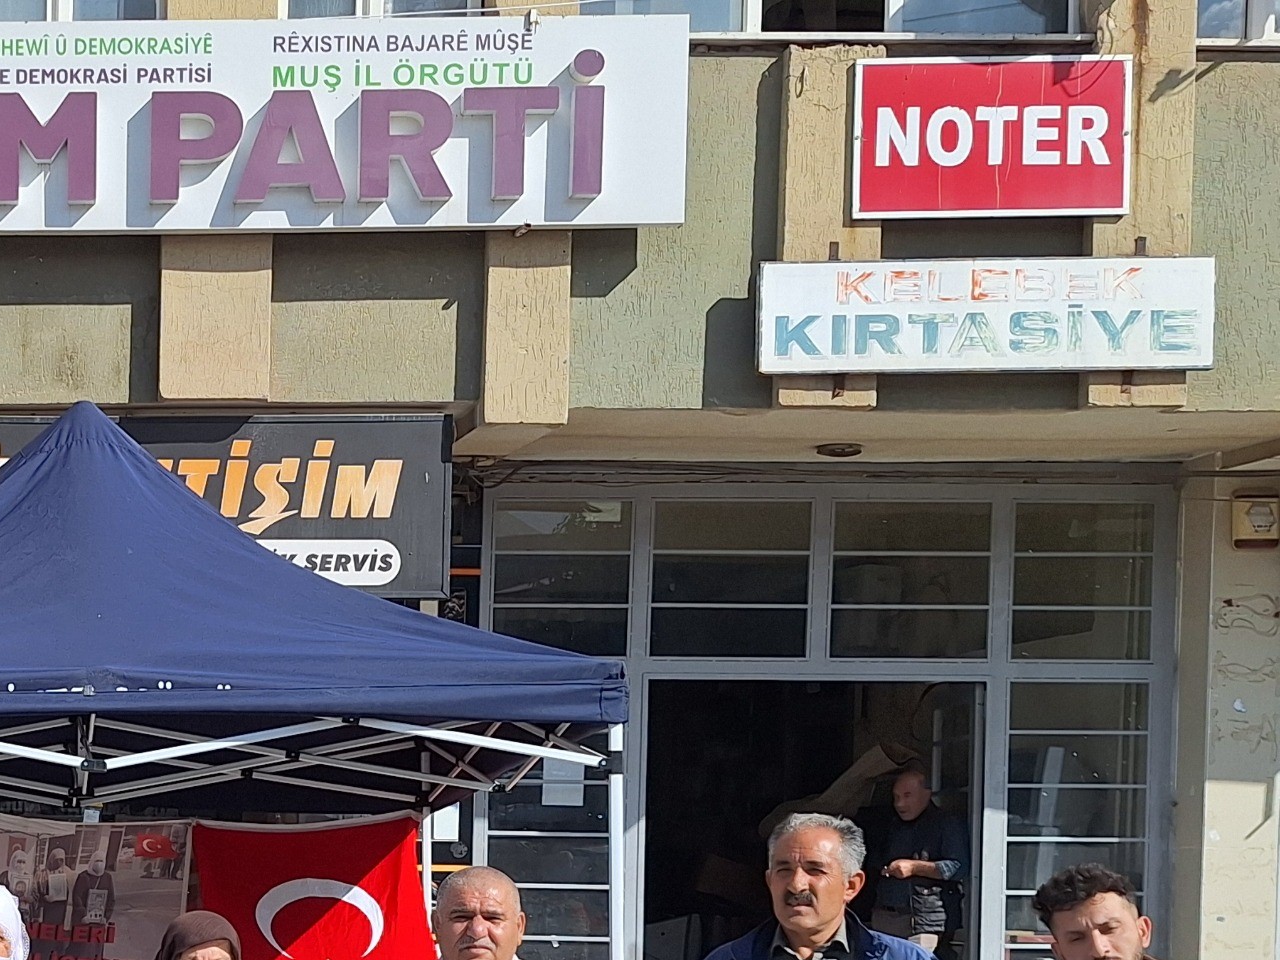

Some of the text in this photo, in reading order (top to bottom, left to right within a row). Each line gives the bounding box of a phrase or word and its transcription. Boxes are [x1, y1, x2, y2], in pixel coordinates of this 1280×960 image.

[54, 34, 68, 56] Û
[74, 29, 213, 55] DEMOKRASİYÊ
[273, 29, 533, 58] RÊXISTINA BAJARÊ MÛŞÊ
[15, 65, 128, 86] DEMOKRASİ
[136, 64, 213, 84] PARTİSİ
[273, 57, 534, 93] MUŞ İL ÖRGÜTÜ
[149, 48, 605, 205] PARTİ
[875, 104, 1111, 167] NOTER
[836, 267, 1144, 303] KELEBEK
[774, 303, 1201, 358] KIRTASİYE
[157, 440, 404, 536] TİŞİM
[304, 549, 393, 572] SERVİS
